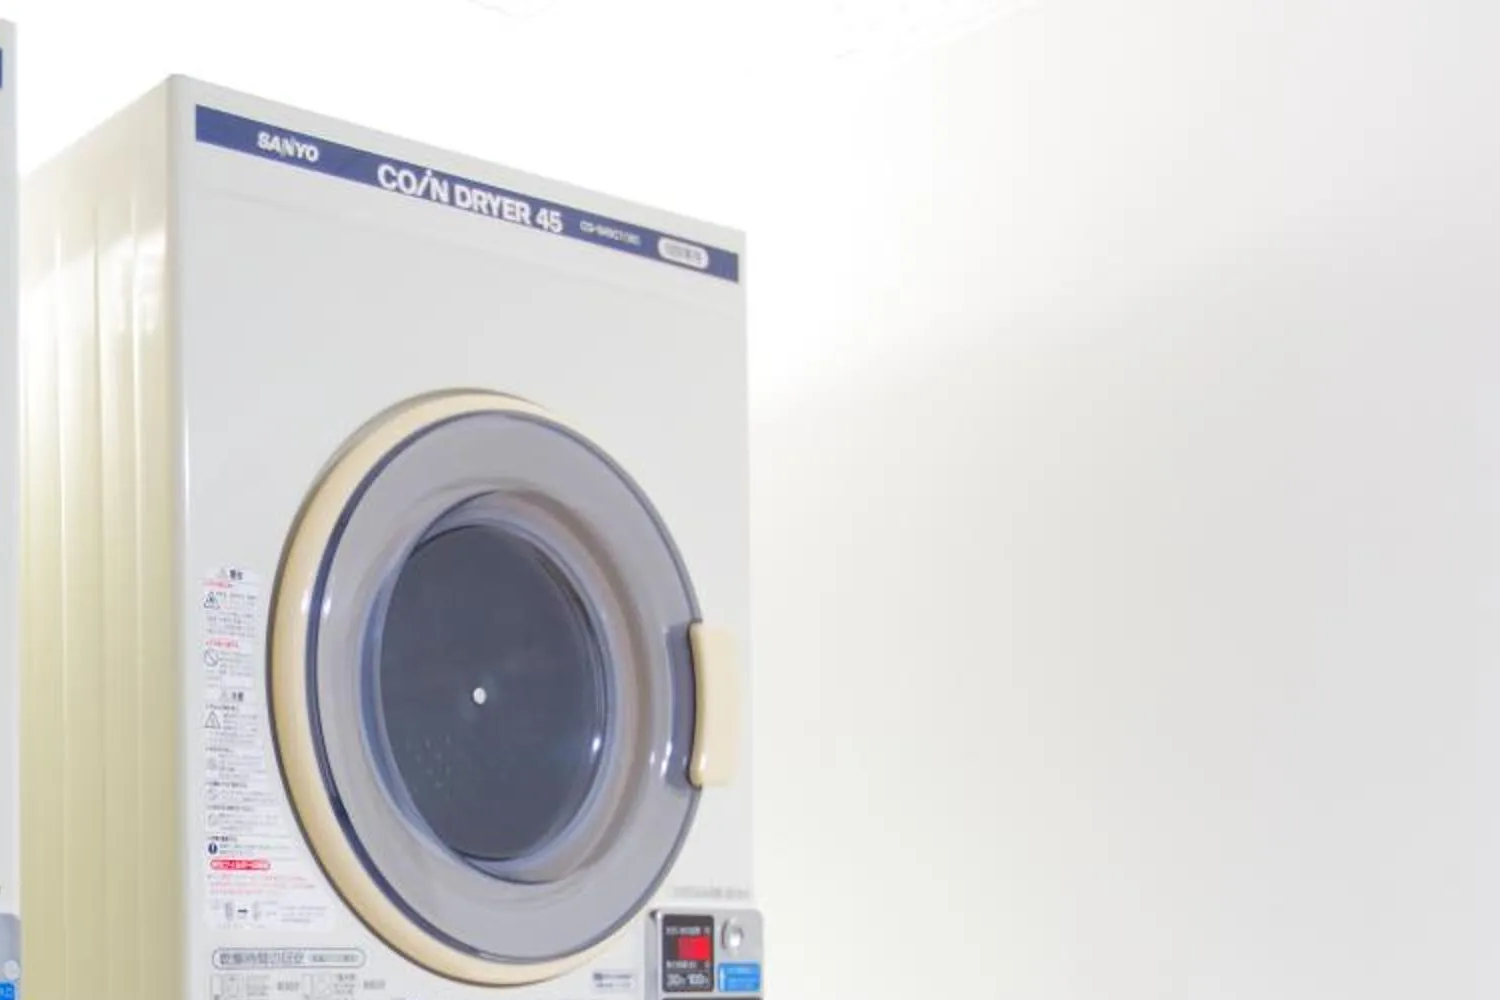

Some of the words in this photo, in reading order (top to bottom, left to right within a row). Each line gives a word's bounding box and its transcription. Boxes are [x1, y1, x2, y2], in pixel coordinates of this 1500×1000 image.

[257, 131, 319, 163] SANYO
[454, 184, 532, 227] DRYER
[534, 208, 563, 233] 45
